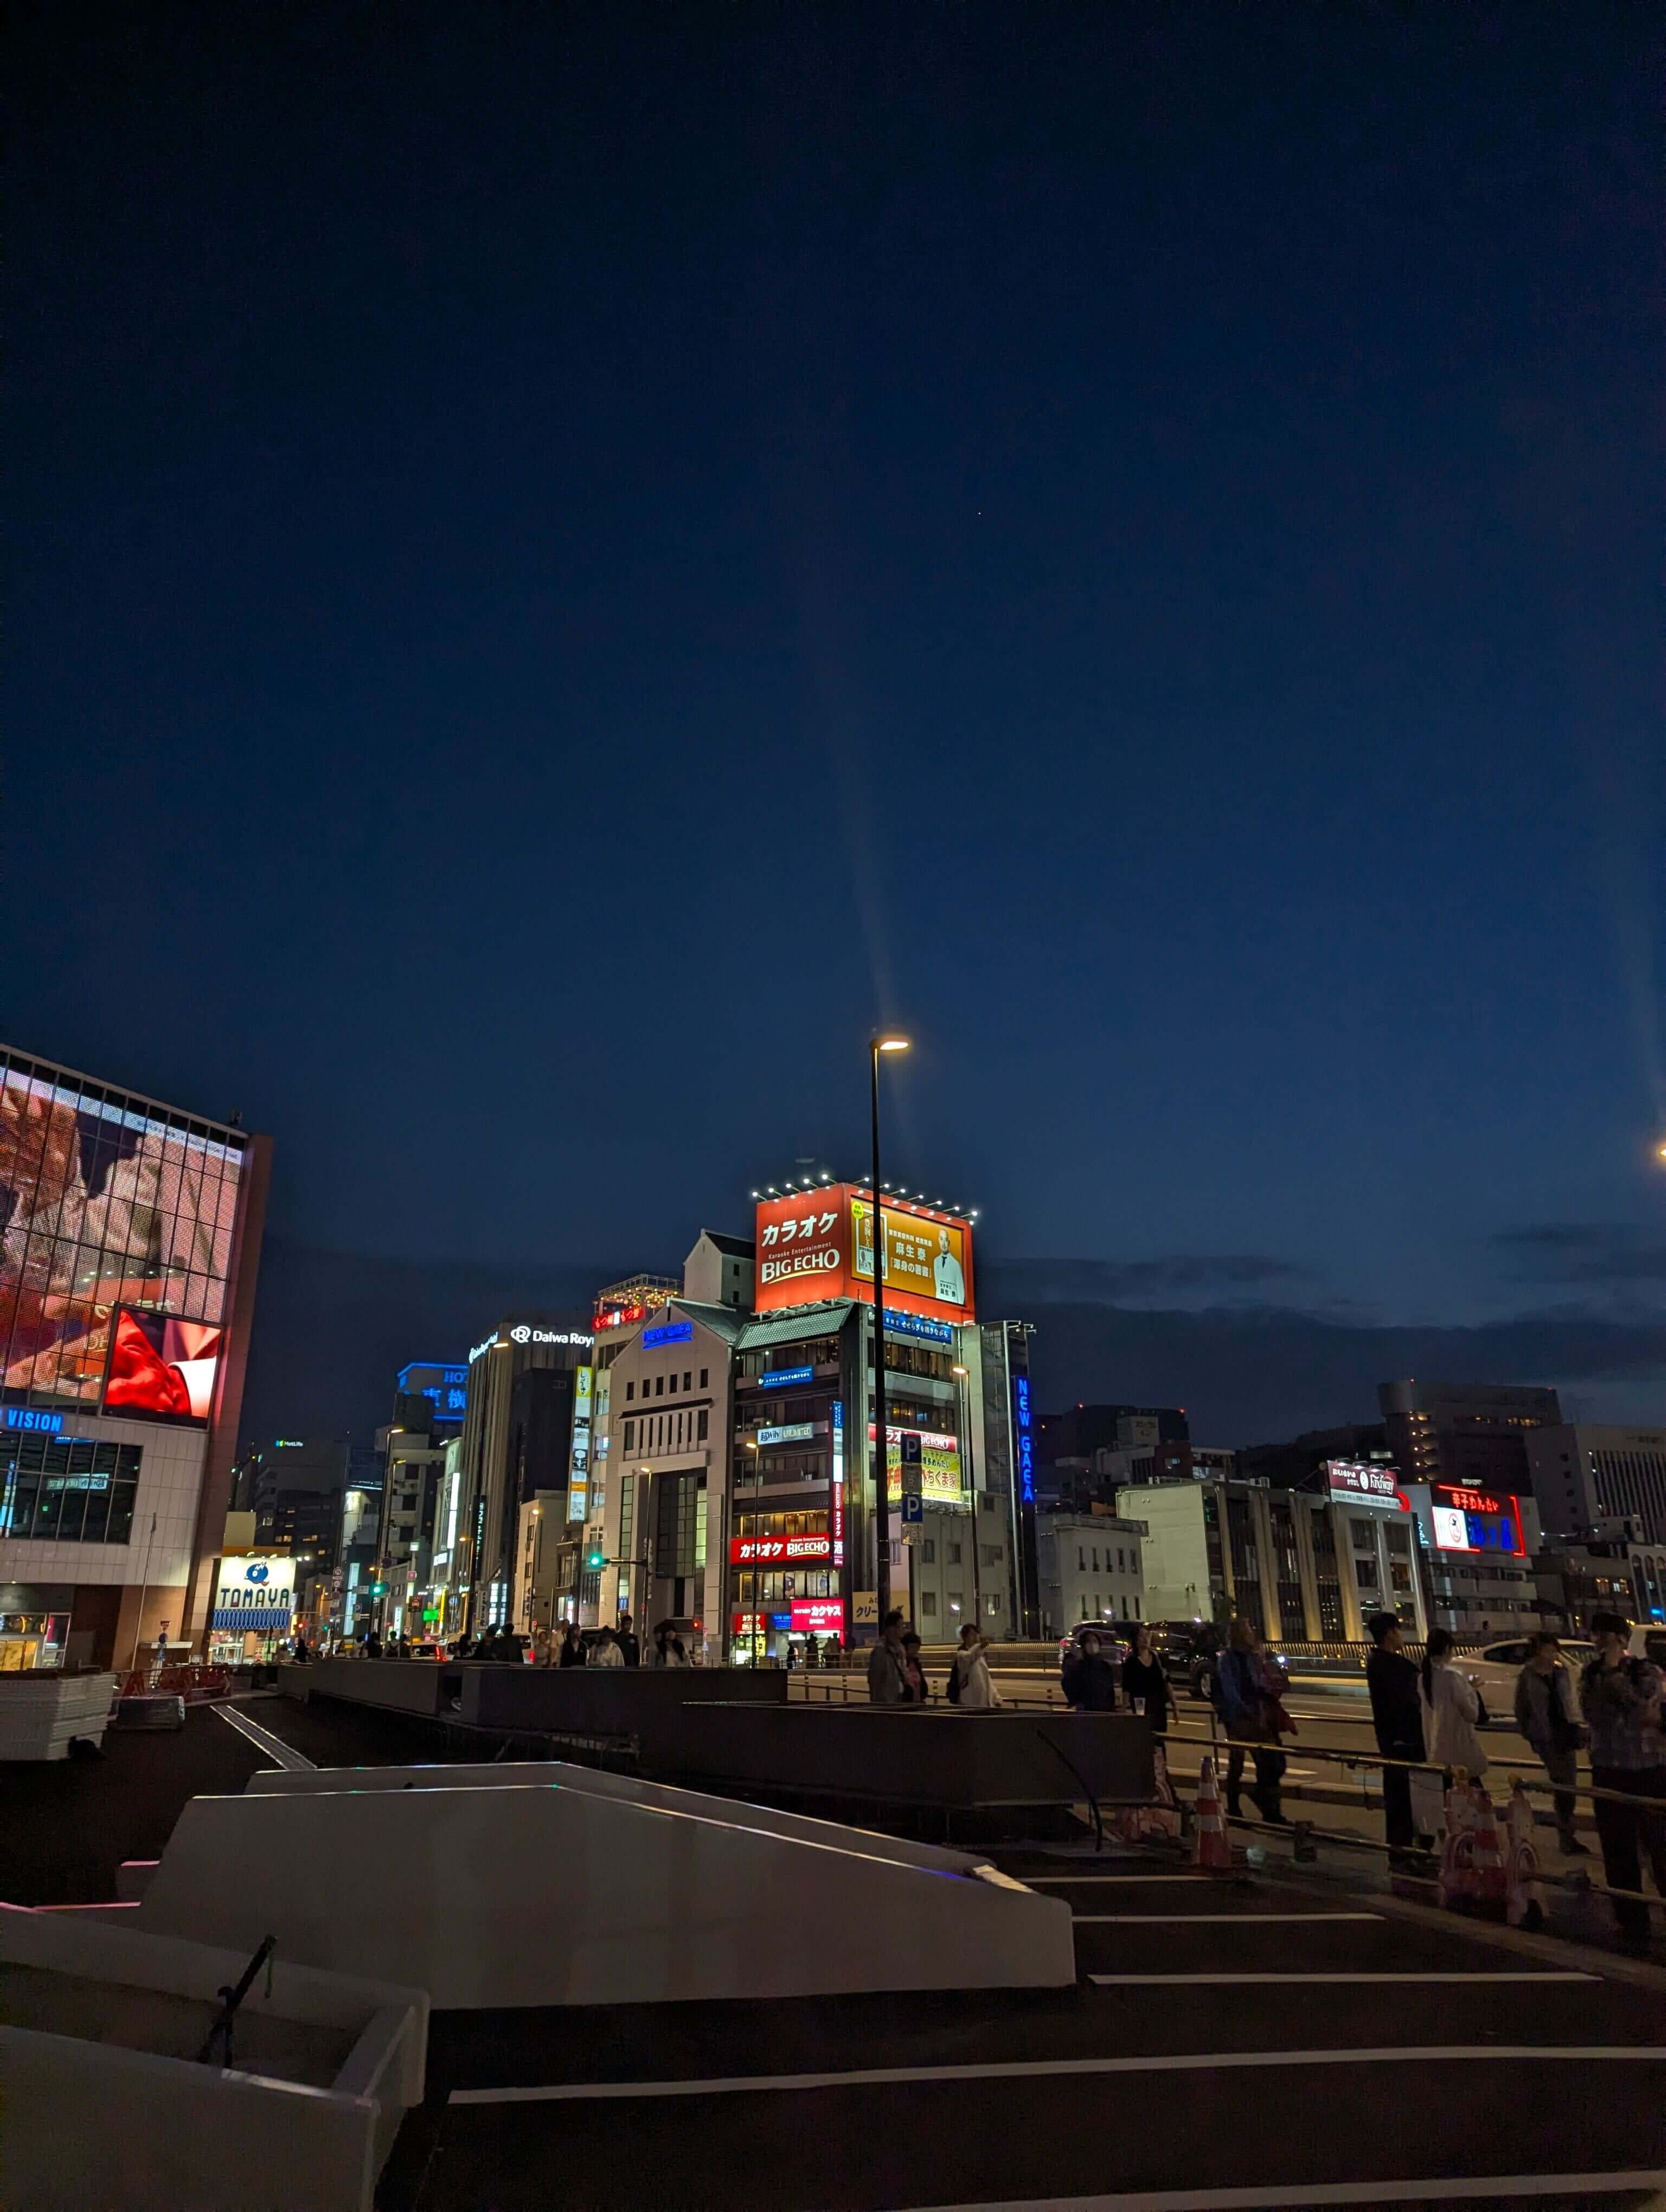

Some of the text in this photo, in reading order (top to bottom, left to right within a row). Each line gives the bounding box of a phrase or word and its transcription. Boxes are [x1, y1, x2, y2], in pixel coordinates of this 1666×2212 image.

[761, 1212, 838, 1247] カラオケ
[768, 1242, 832, 1260] Karaoke Entertainment
[896, 1242, 914, 1258] 麻生
[533, 1331, 568, 1343] Daiwa
[644, 1328, 664, 1342] NEW
[8, 1409, 62, 1432] VISION
[783, 1426, 811, 1437] UNLIMITED
[1019, 1379, 1033, 1501] NEW GAEA
[906, 1439, 918, 1460] P
[907, 1496, 919, 1520] P
[740, 1542, 783, 1558] カラオケ
[834, 1541, 843, 1554] 酒
[811, 1605, 841, 1617] カクヤス
